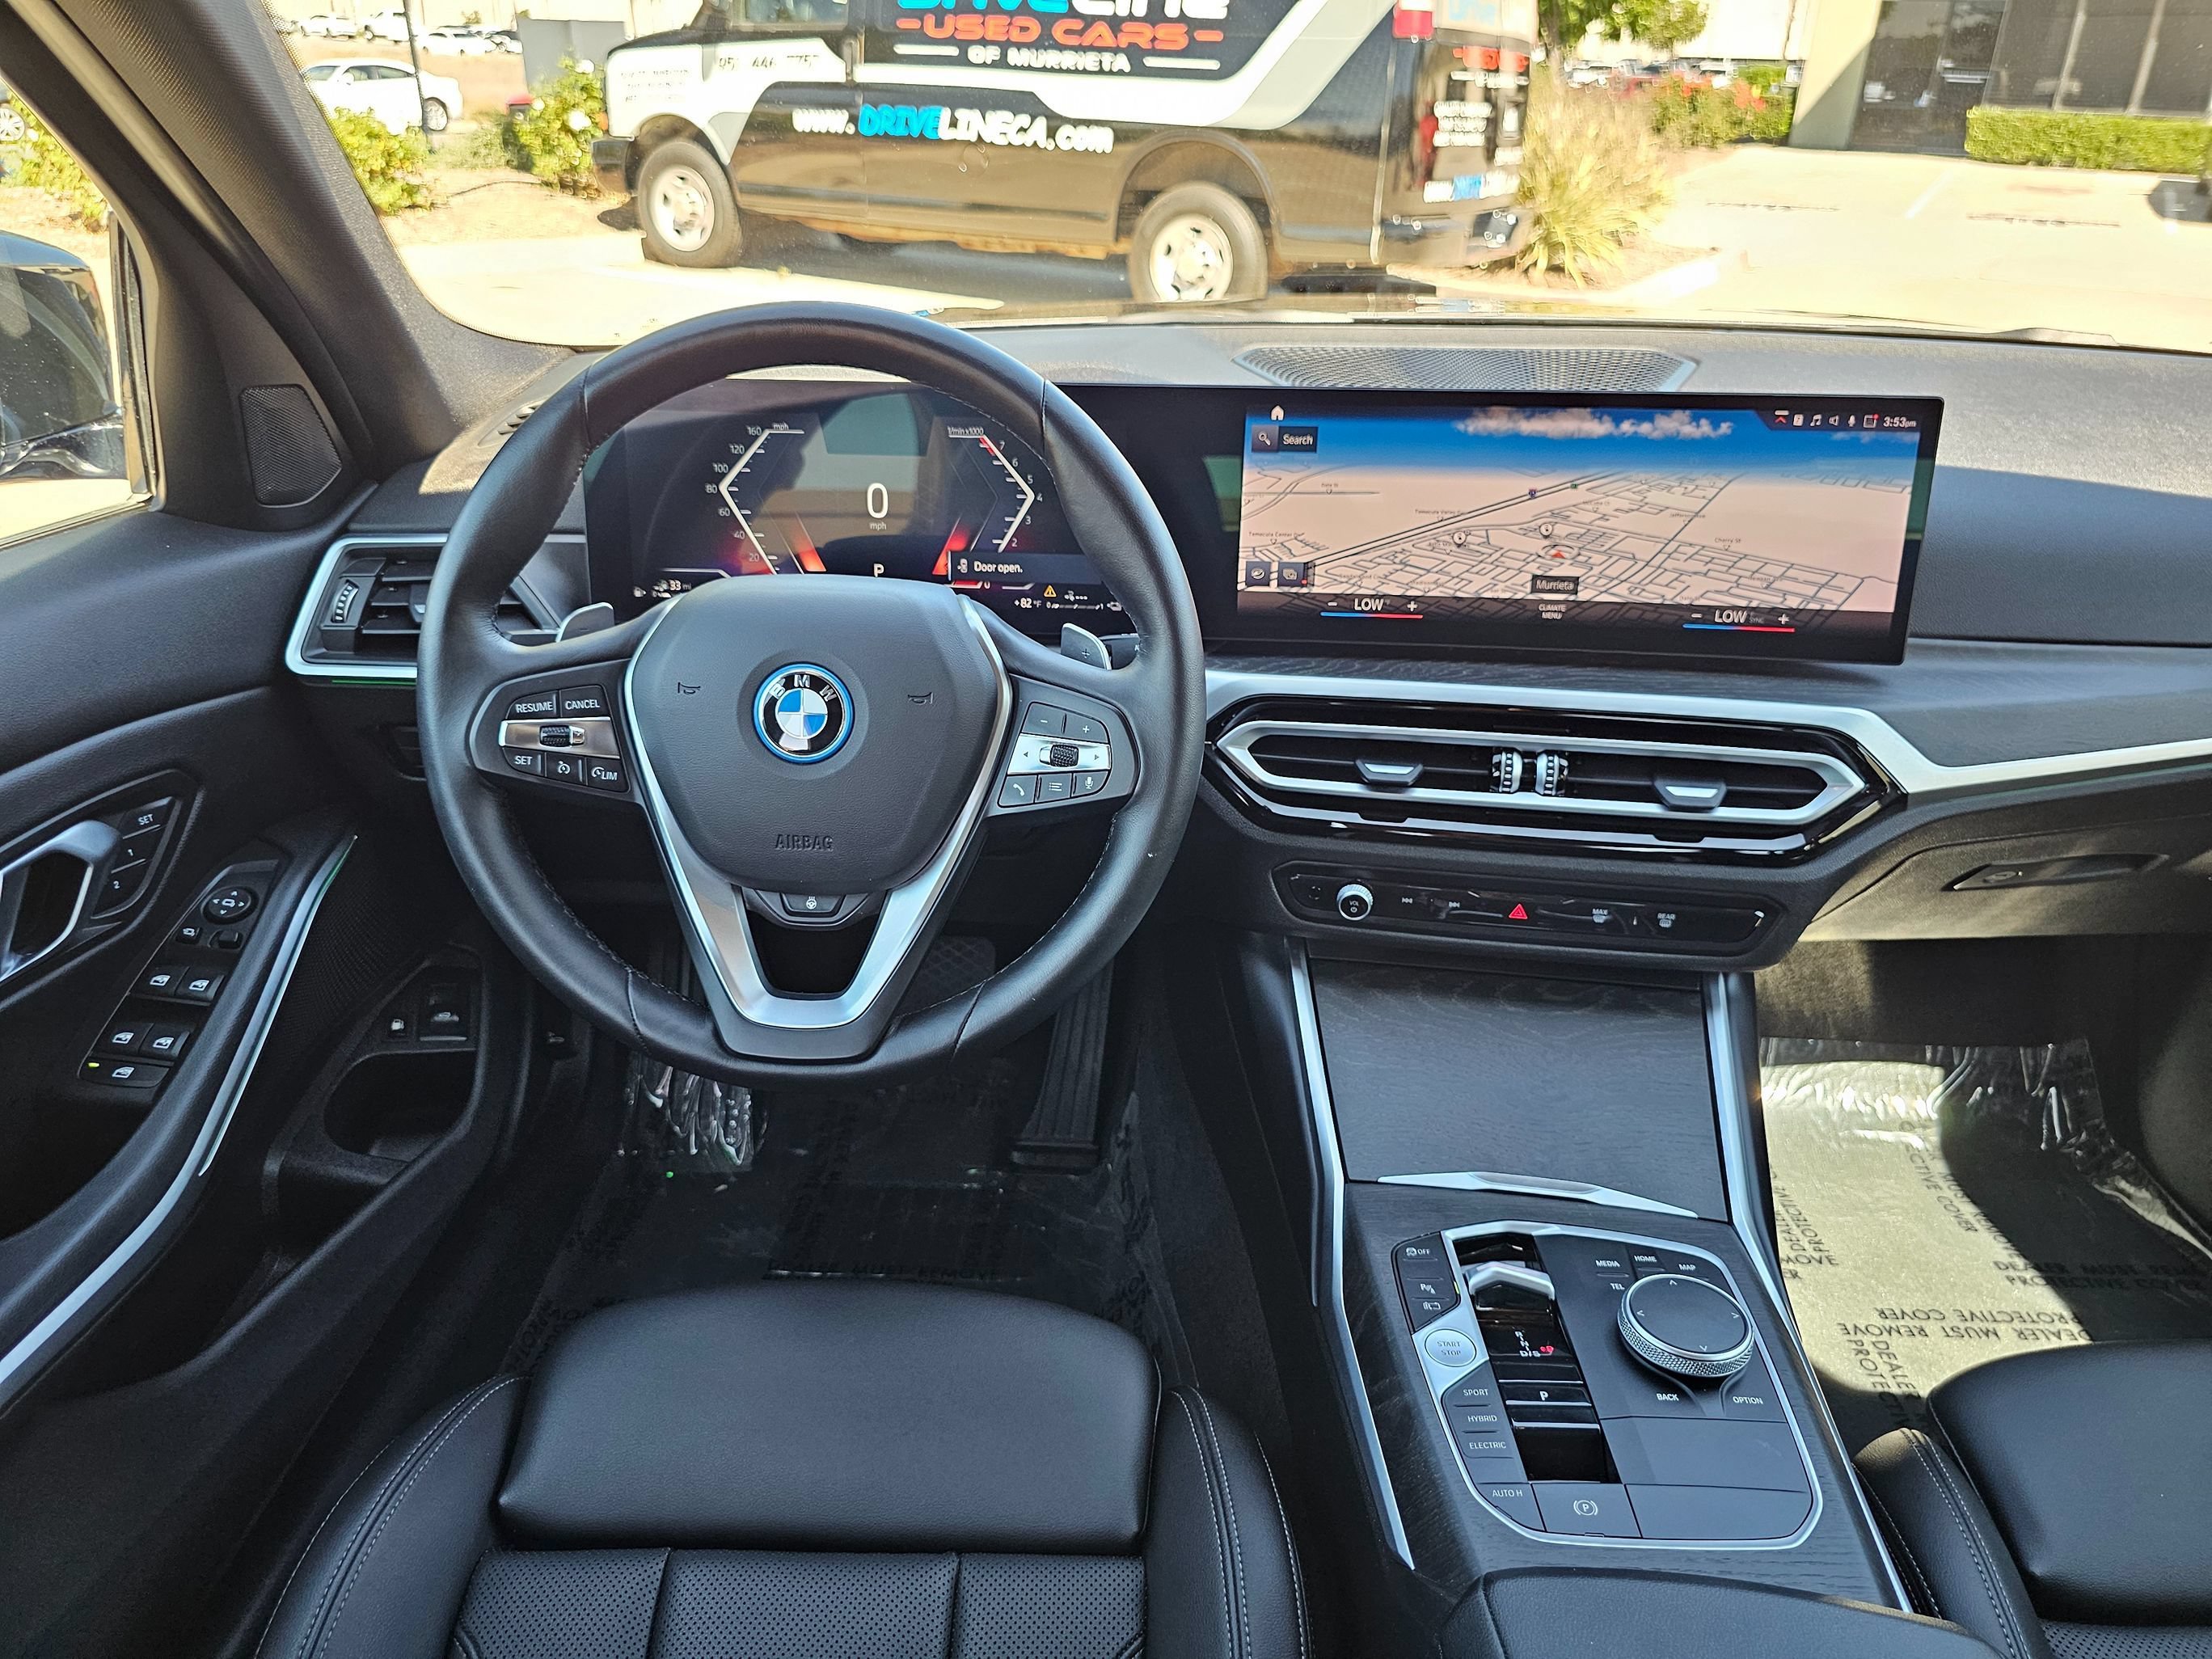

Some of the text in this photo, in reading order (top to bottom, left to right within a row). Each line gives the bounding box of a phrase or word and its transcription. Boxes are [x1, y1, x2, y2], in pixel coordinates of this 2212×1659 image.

[923, 14, 1189, 50] USED CARS
[968, 44, 1131, 73] OF MURRIETA
[746, 425, 762, 436] 160
[1282, 433, 1314, 445] Search
[729, 443, 745, 454] 120
[998, 441, 1005, 450] 7
[712, 462, 728, 473] 100
[1012, 458, 1019, 467] 6
[1027, 475, 1033, 484] 5
[705, 483, 718, 494] 80
[867, 483, 889, 519] 0
[1036, 493, 1043, 502] 4
[718, 507, 731, 517] 60
[1025, 515, 1032, 525] 3
[869, 521, 887, 531] mph
[733, 530, 745, 540] 40
[1011, 538, 1017, 547] 2
[749, 553, 760, 562] 20
[873, 563, 884, 577] P
[973, 560, 1024, 574] Door open.
[668, 579, 692, 591] 33 mi
[1536, 579, 1575, 591] Murrieta
[1354, 597, 1385, 611] LOW
[1714, 609, 1748, 623] LOW
[768, 673, 838, 702] BMW
[515, 700, 553, 713] RESUME
[565, 699, 601, 710] CANCEL
[514, 755, 533, 766] SET
[602, 770, 618, 781] LIM
[137, 813, 154, 825] SET
[775, 834, 834, 851] AIRBAG
[113, 880, 120, 889] 2
[1657, 913, 1675, 921] REAR
[1595, 1259, 1620, 1268] MEDIA
[1633, 1255, 1657, 1263] HOME
[1678, 1264, 1696, 1272] MAP
[1610, 1282, 1625, 1290] TEL
[1875, 1307, 1945, 1321] COVER
[1837, 1323, 2094, 1342] DEALER MUST REMOVE
[1463, 1388, 1489, 1396] SPORT
[1539, 1391, 1548, 1401] P
[1656, 1393, 1679, 1402] BACK
[1733, 1395, 1764, 1405] OPTION
[1467, 1415, 1497, 1423] HYBRID
[1469, 1442, 1507, 1450] ELECTRIC
